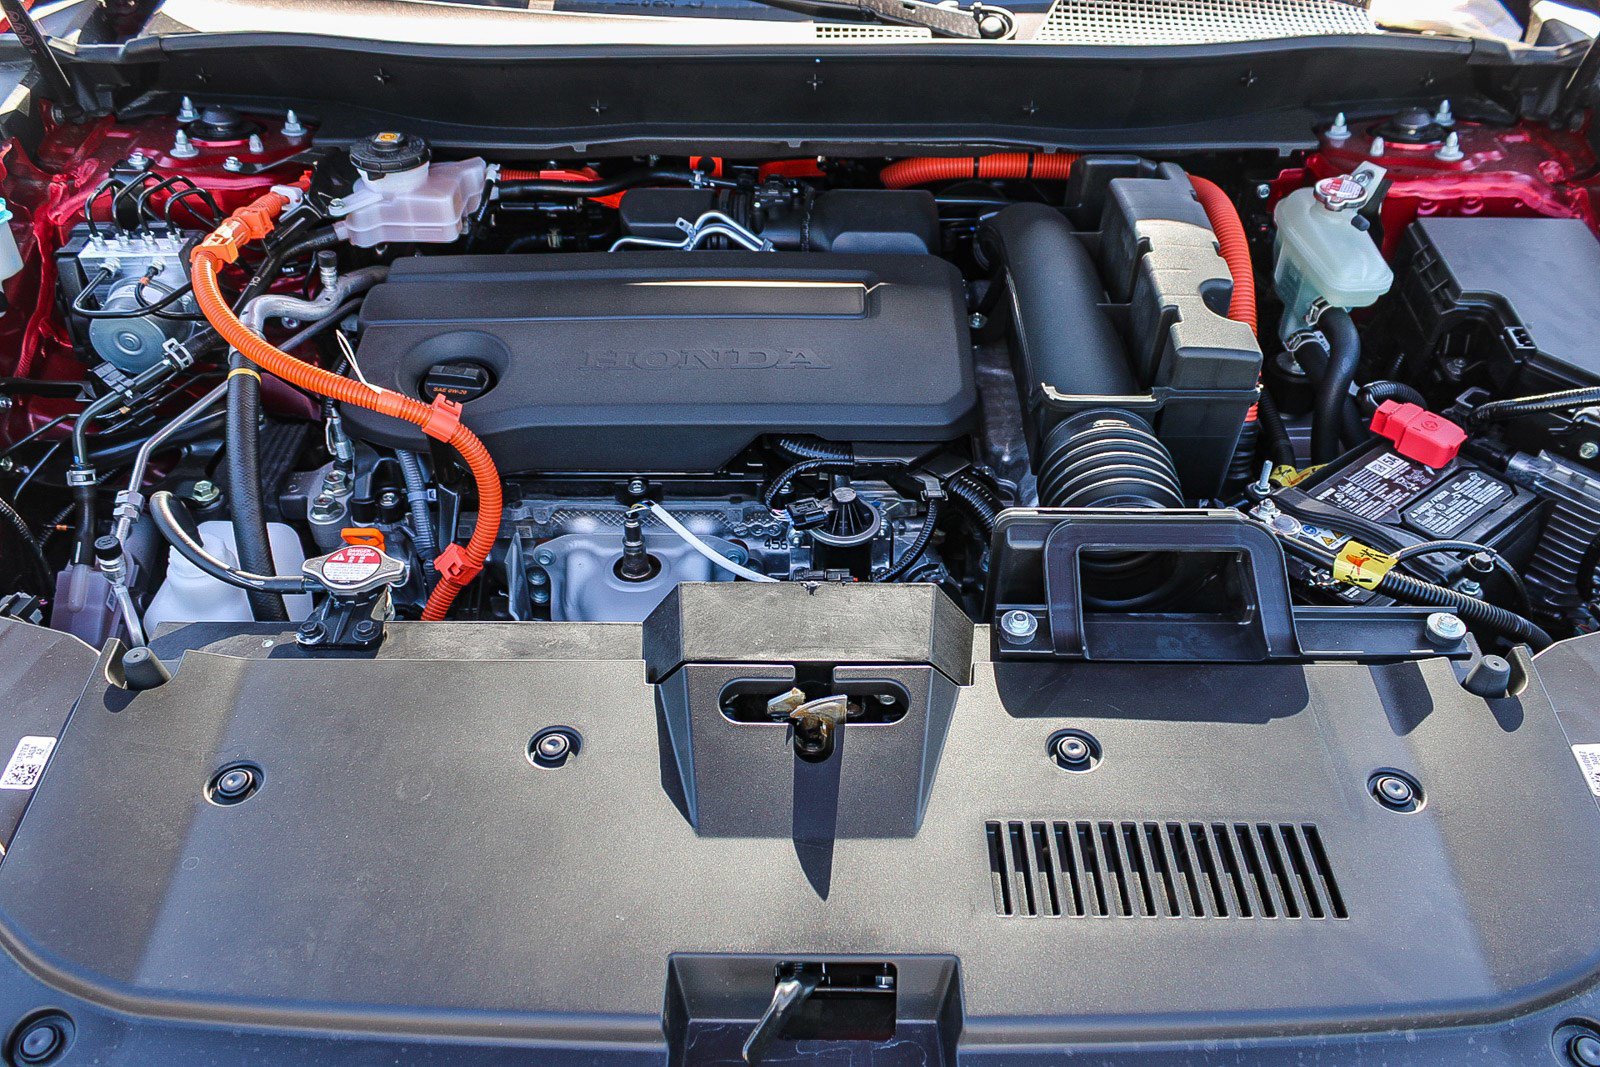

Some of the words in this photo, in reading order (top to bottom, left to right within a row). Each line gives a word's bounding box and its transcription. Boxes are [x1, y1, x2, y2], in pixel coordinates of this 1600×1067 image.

[577, 348, 832, 370] HONDA
[1382, 455, 1400, 466] 5A
[764, 538, 788, 550] 456
